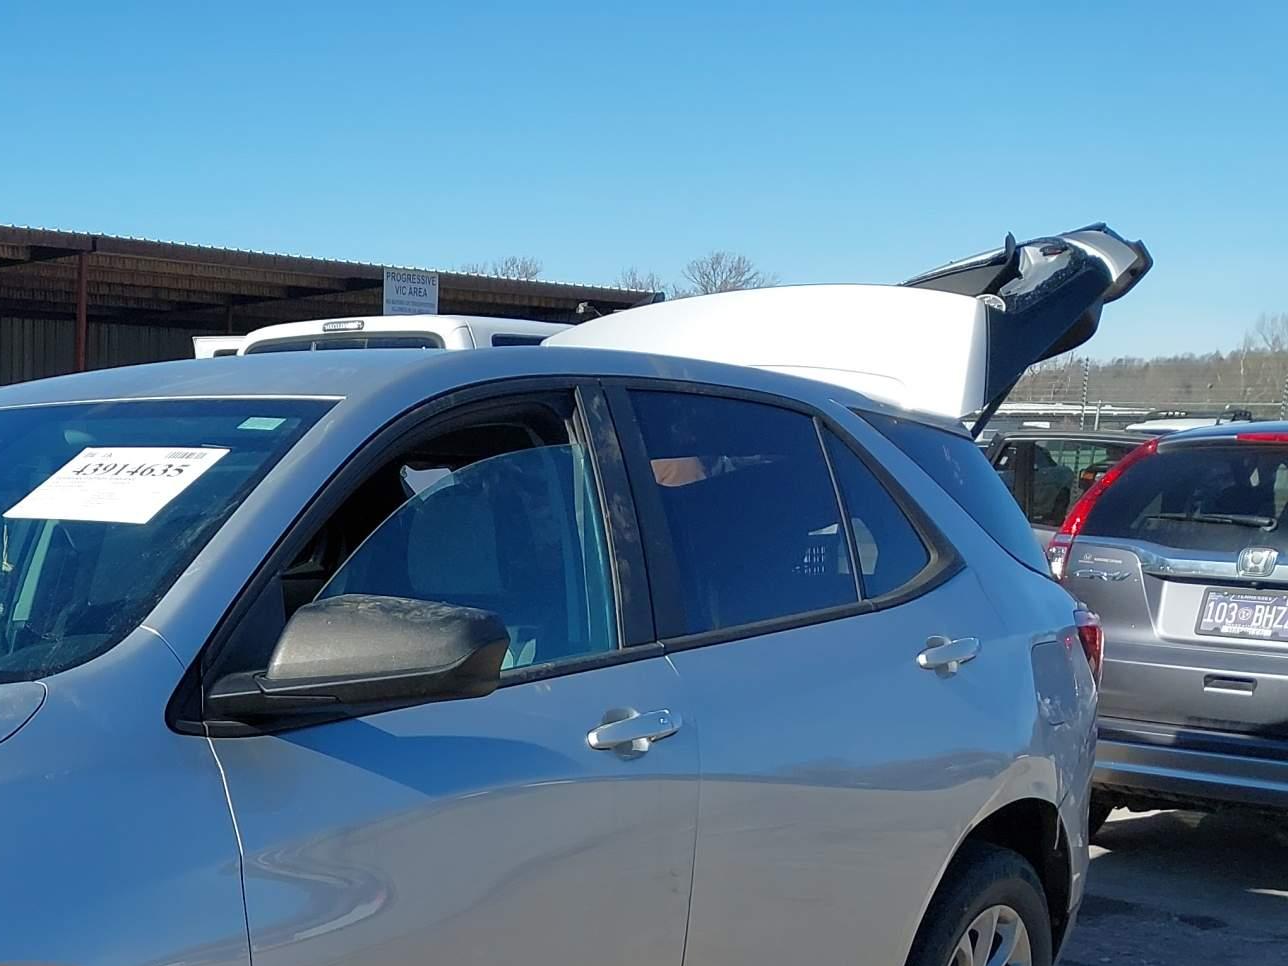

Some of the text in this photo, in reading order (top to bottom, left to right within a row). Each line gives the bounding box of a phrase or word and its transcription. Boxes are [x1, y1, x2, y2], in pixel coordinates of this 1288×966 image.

[386, 271, 437, 287] PROGRESSIVE
[395, 285, 428, 298] VIC AREA
[73, 463, 191, 477] 43914635
[1203, 601, 1288, 629] 103 BHZ
